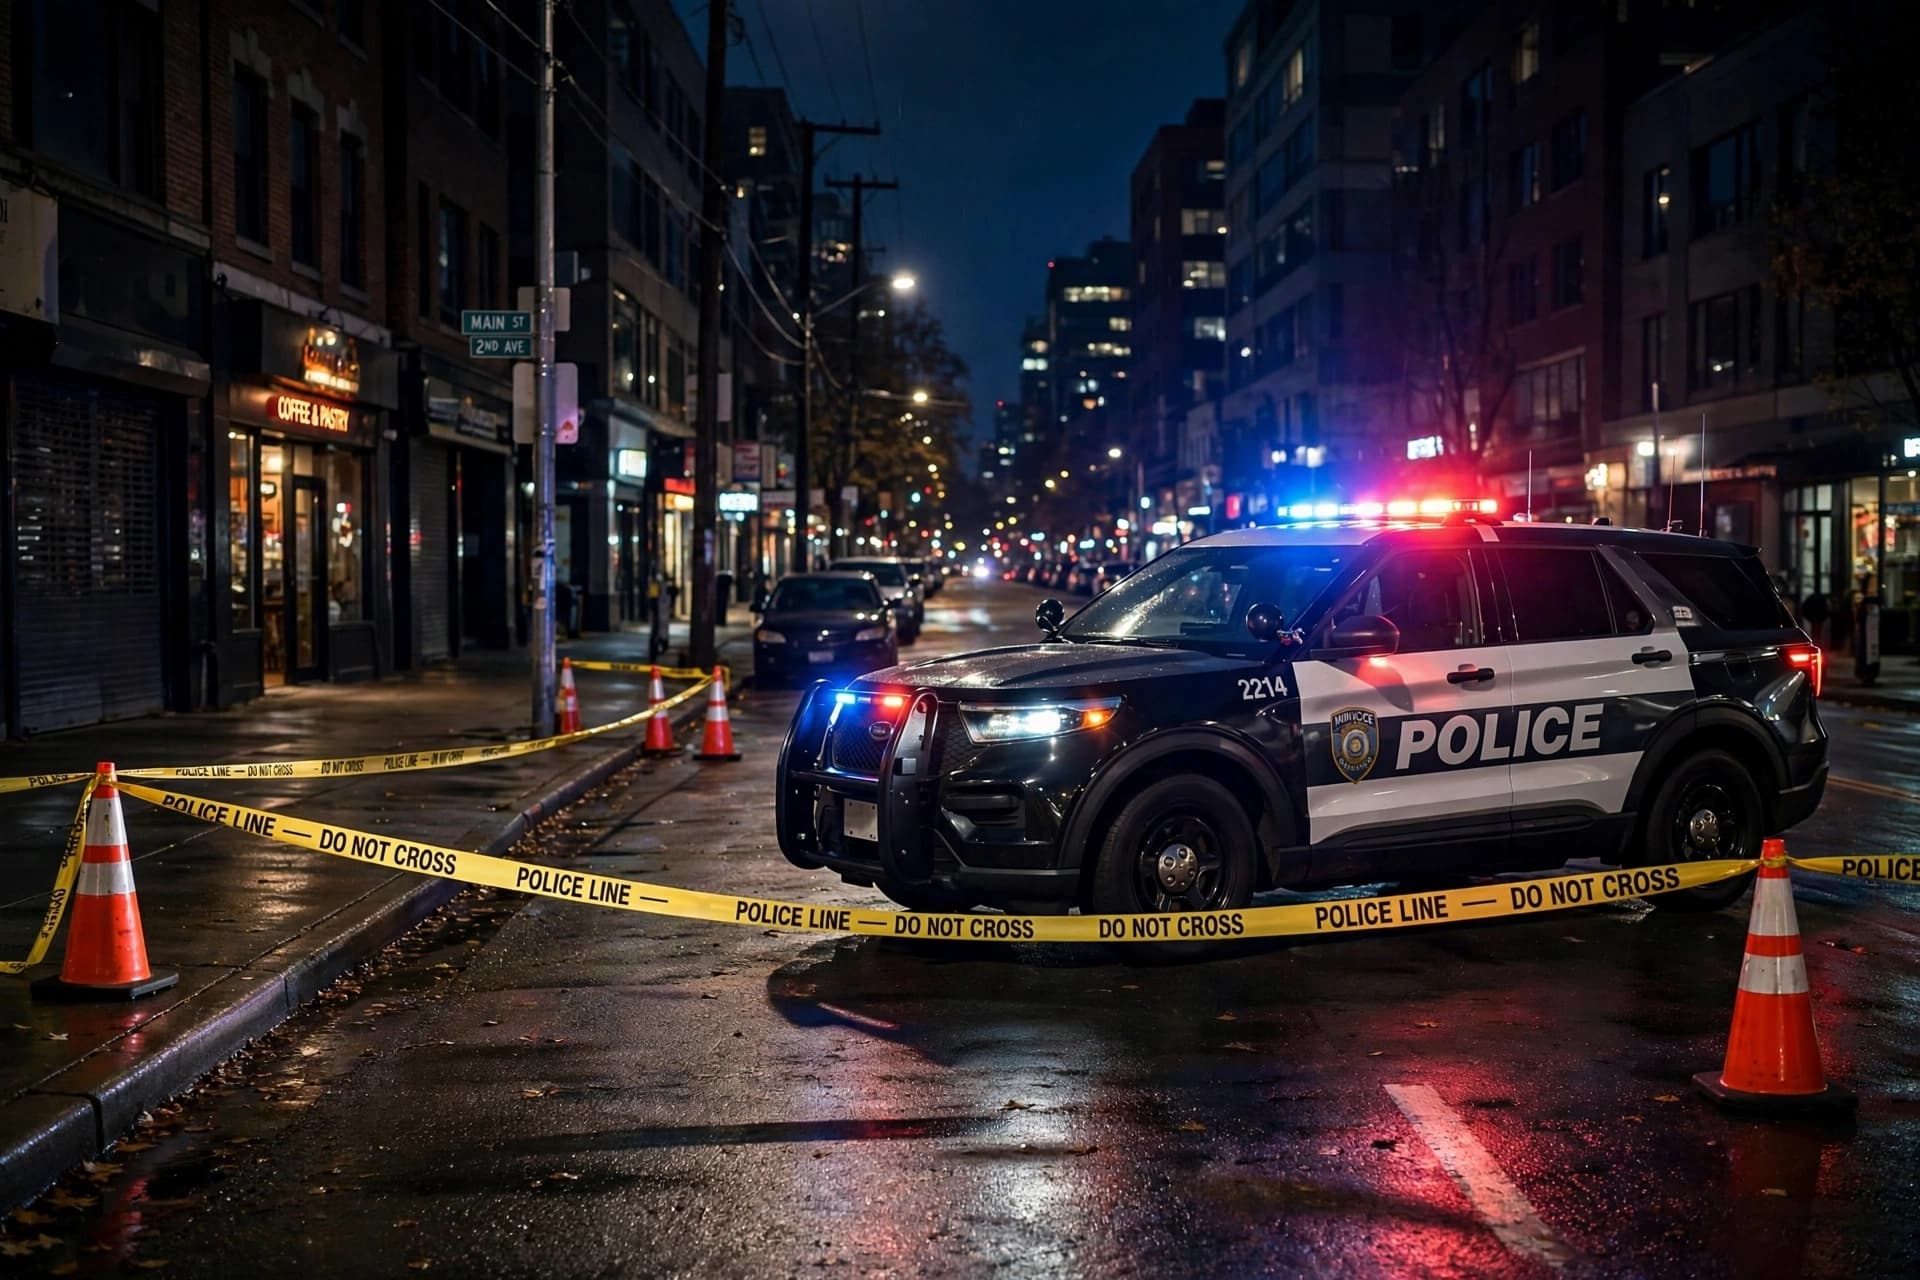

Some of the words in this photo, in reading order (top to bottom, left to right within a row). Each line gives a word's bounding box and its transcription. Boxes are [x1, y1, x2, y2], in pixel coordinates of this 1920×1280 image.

[471, 315, 505, 330] MAIN
[512, 316, 525, 329] ST
[476, 339, 500, 354] 2ND
[504, 341, 525, 353] AVE
[278, 396, 311, 425] COFFEE
[320, 405, 350, 433] PASTRY
[1237, 675, 1289, 701] 2214
[1395, 702, 1605, 771] POLICE
[162, 794, 229, 823] POLICE
[233, 810, 277, 837] LINE
[319, 829, 347, 852] DO
[352, 836, 391, 861] NOT
[394, 844, 457, 875] CROSS
[516, 867, 585, 898] POLICE
[589, 879, 632, 906] LINE
[1315, 900, 1393, 929] POLICE
[1400, 895, 1449, 922] LINE
[1510, 883, 1543, 910] DO
[1550, 877, 1595, 906] NOT
[1602, 867, 1681, 900] CROSS
[736, 900, 803, 927] POLICE
[809, 908, 851, 931] LINE
[894, 915, 921, 935] DO
[927, 917, 965, 938] NOT
[969, 918, 1034, 939] CROSS
[1100, 917, 1124, 939] DO
[1132, 916, 1172, 938] NOT
[1178, 912, 1245, 937] CROSS
